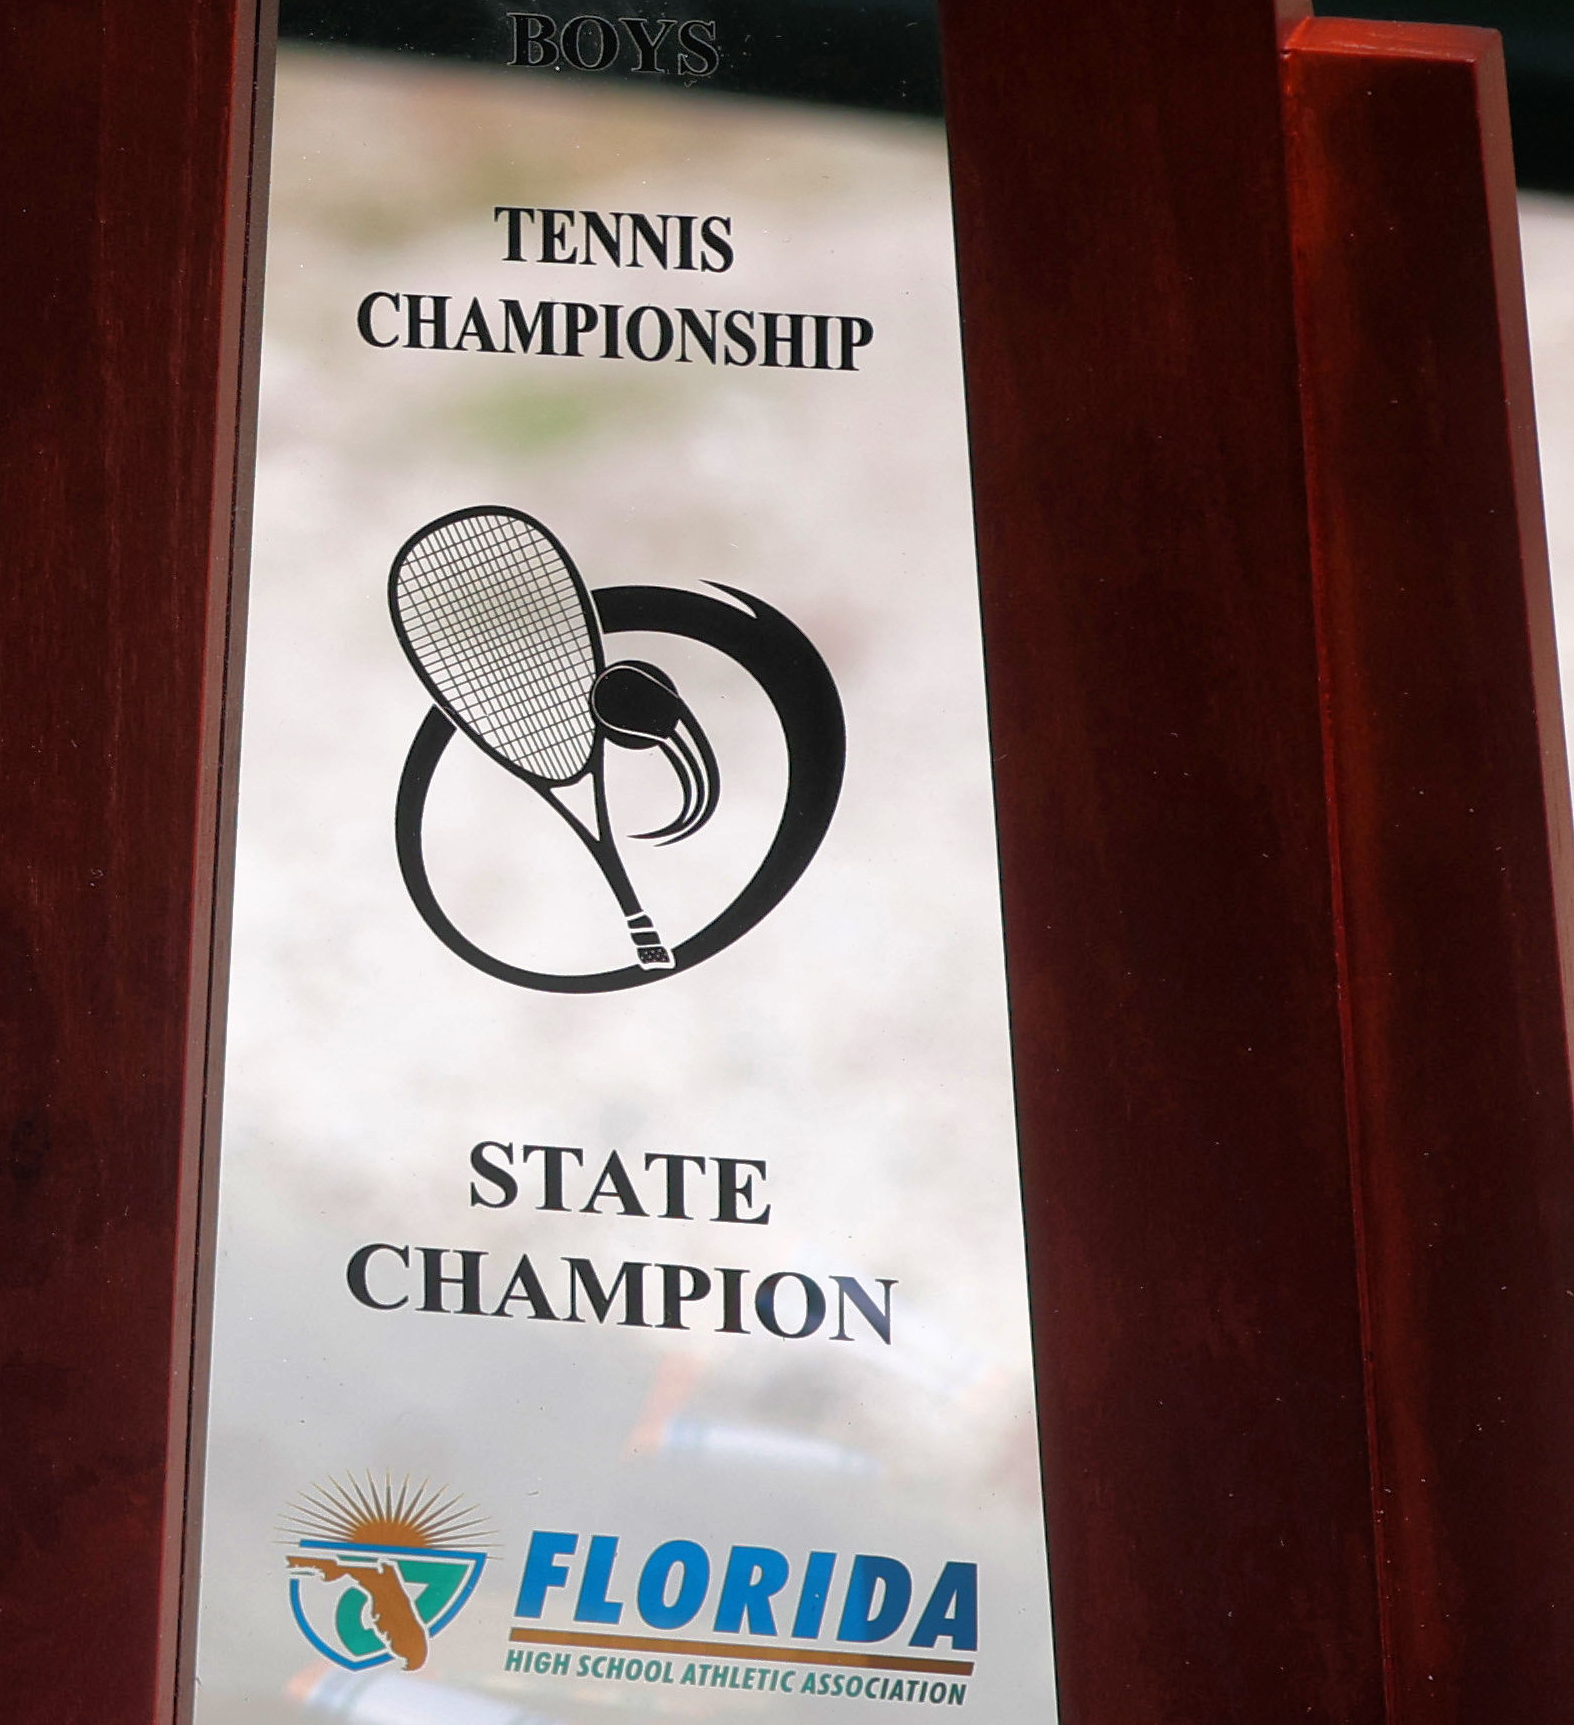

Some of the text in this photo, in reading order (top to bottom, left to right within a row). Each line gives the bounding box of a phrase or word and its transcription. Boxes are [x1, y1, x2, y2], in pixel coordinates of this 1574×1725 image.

[507, 12, 719, 76] BOYS
[495, 207, 734, 273] TENNIS
[357, 291, 873, 371] CHAMPIONSHIP
[469, 1140, 771, 1225] STATE
[346, 1242, 898, 1345] CHAMPION
[513, 1530, 978, 1651] FLORIDA
[505, 1649, 967, 1705] HIGH SCHOOL ATHLETIC ASSOCIATION
